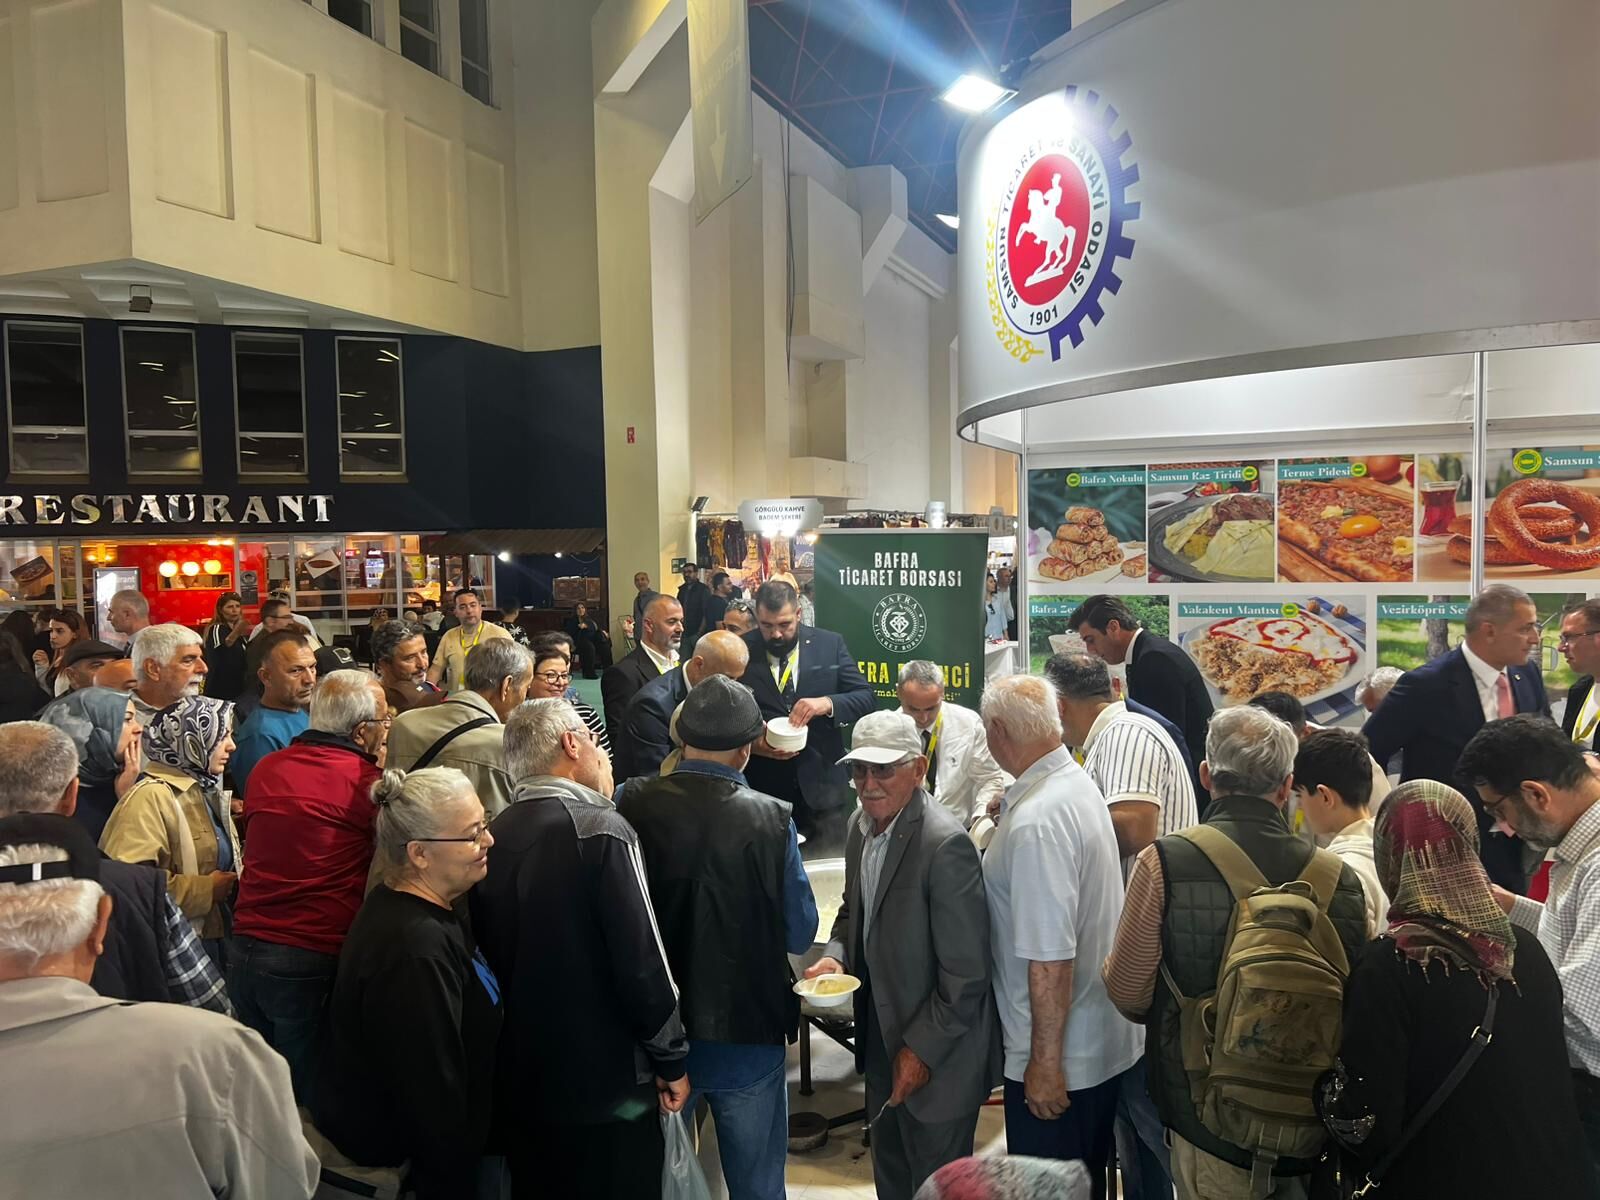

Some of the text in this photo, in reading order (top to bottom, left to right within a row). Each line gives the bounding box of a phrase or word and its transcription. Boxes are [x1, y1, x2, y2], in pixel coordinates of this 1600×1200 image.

[1068, 135, 1108, 211] SANAYİ
[1071, 220, 1103, 295] ODASI
[999, 226, 1019, 309] SAMSUN
[1029, 304, 1059, 327] 1901
[1544, 456, 1593, 466] Samsun
[1081, 474, 1143, 484] Bafra Nokulu
[1192, 471, 1211, 480] Kaz
[1213, 469, 1241, 479] Tiridi
[1281, 466, 1350, 477] Terme Pidesi
[0, 494, 336, 524] RESTAURANT
[874, 552, 919, 569] BAFRA
[839, 566, 962, 587] TİCARET BORSASI
[880, 595, 917, 610] BAFRA
[1031, 604, 1057, 614] Bafra
[1182, 604, 1280, 615] Yakakent Mantısı
[1381, 604, 1446, 617] Vezirköprü
[857, 661, 890, 684] FRA
